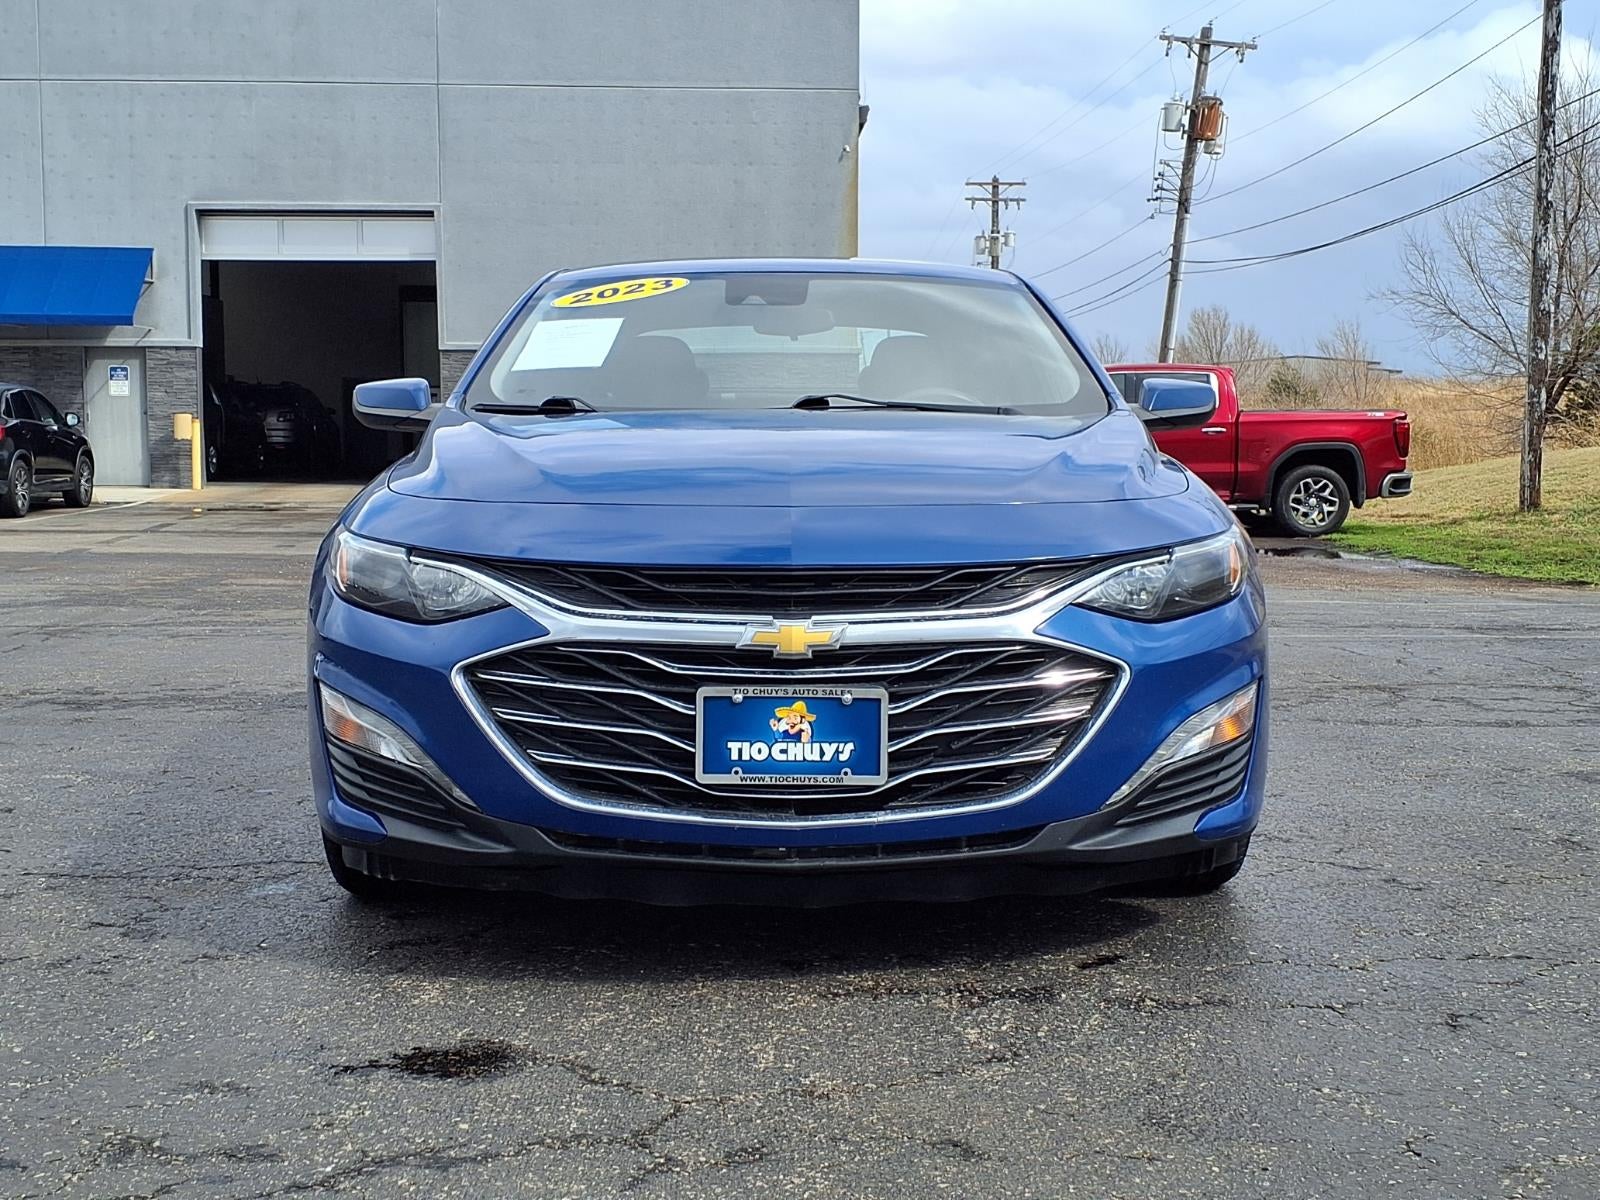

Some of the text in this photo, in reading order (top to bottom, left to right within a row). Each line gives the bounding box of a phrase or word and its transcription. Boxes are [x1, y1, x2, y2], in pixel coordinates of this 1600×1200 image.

[569, 279, 673, 305] 2023
[752, 688, 789, 696] CHUY'S
[739, 775, 844, 784] WWW.TIOCHUYS.COM
